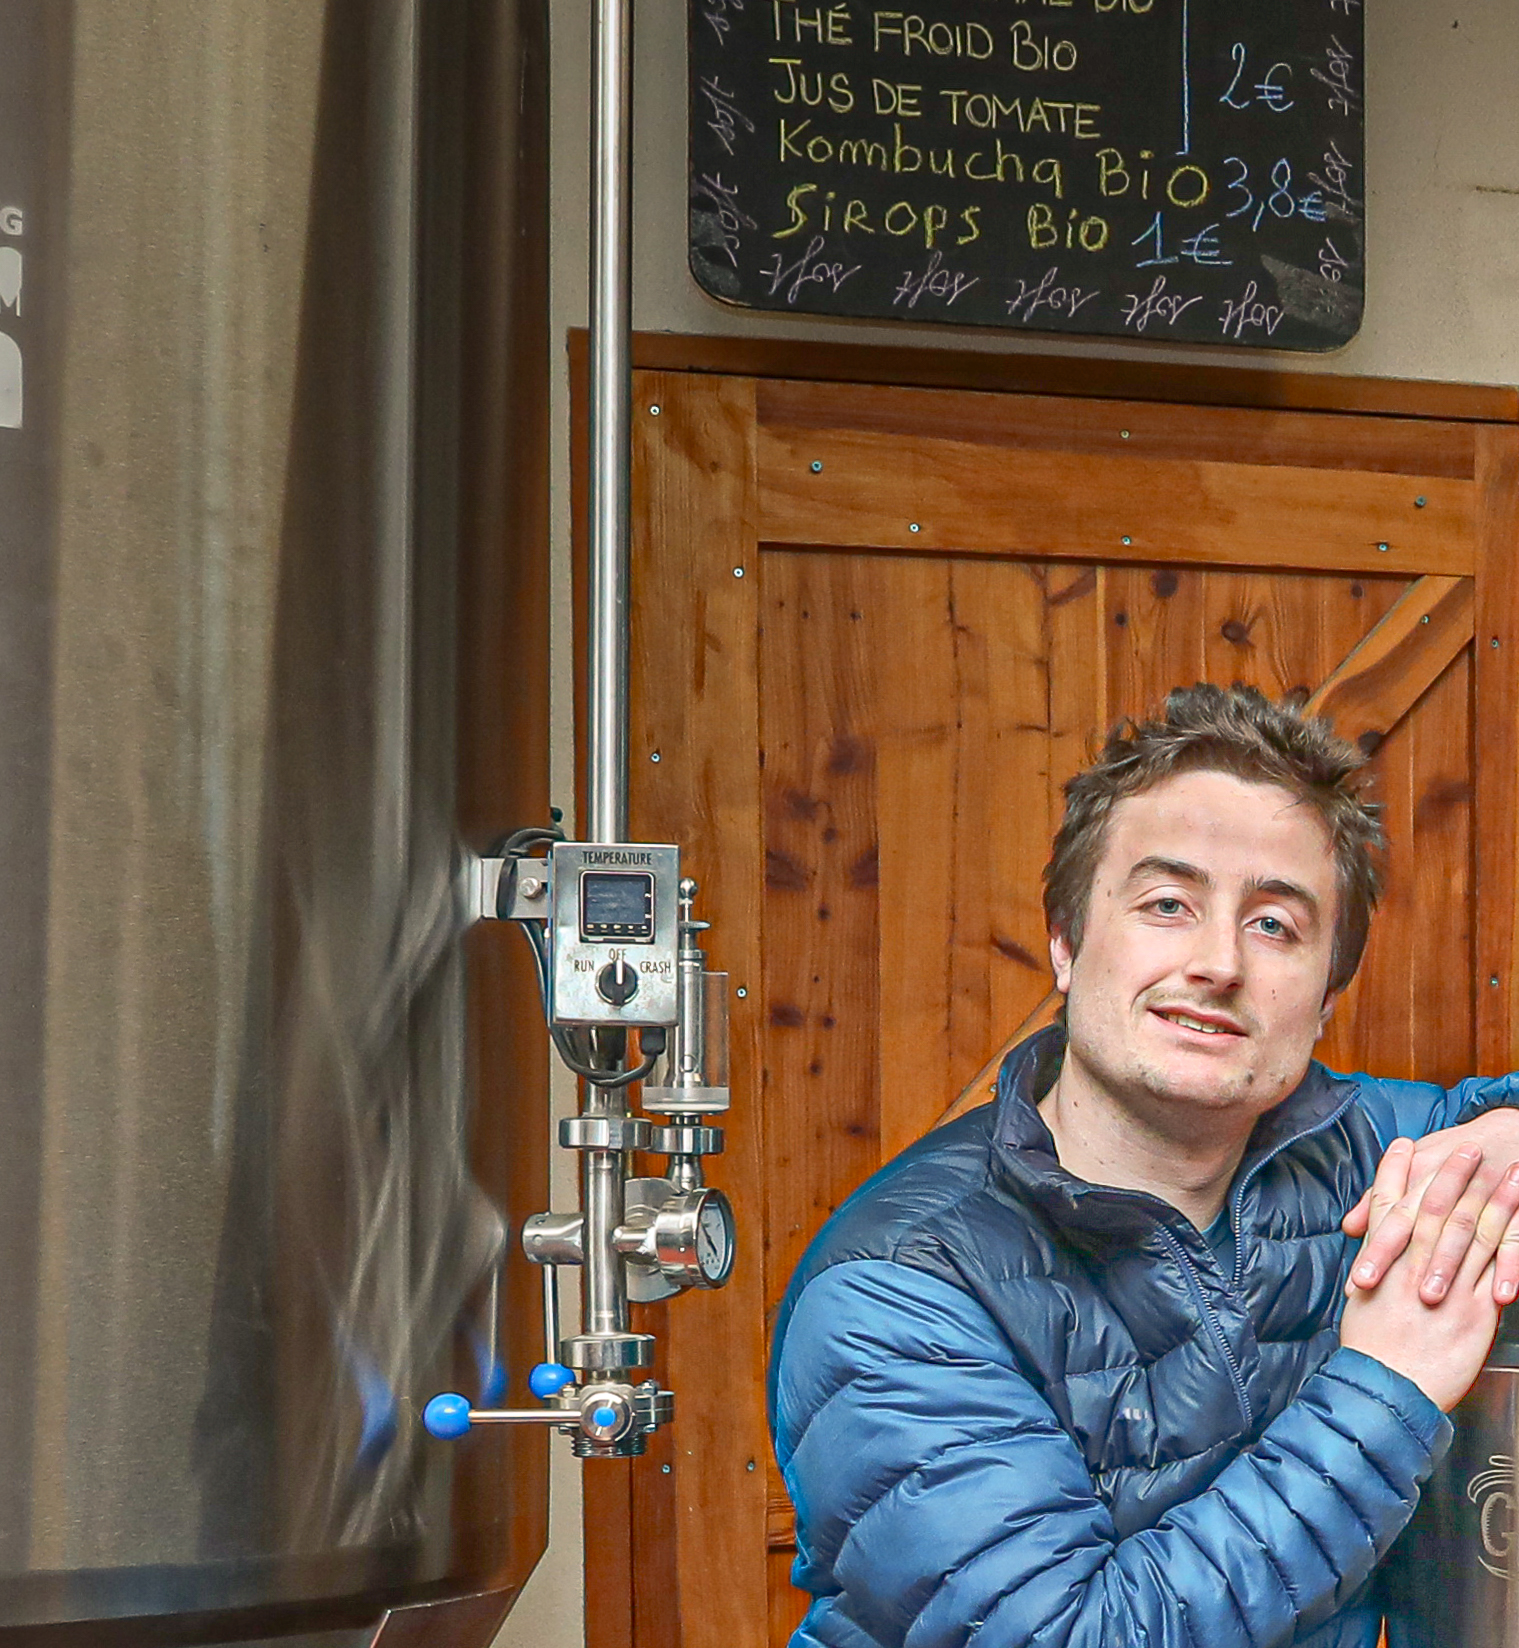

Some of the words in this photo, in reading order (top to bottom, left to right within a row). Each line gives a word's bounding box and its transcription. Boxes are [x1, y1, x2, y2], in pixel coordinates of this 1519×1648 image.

[768, 0, 852, 45] THÉ
[874, 11, 994, 59] FROID
[768, 57, 853, 113] JUS
[872, 78, 921, 116] DE
[939, 90, 1101, 139] TOMATE
[1219, 42, 1294, 112] 2€
[778, 118, 1063, 198] Kombucha
[1131, 211, 1233, 268] 1€
[582, 851, 652, 866] TEMPERATURE
[574, 960, 595, 972] RUN
[640, 960, 671, 974] CRASH
